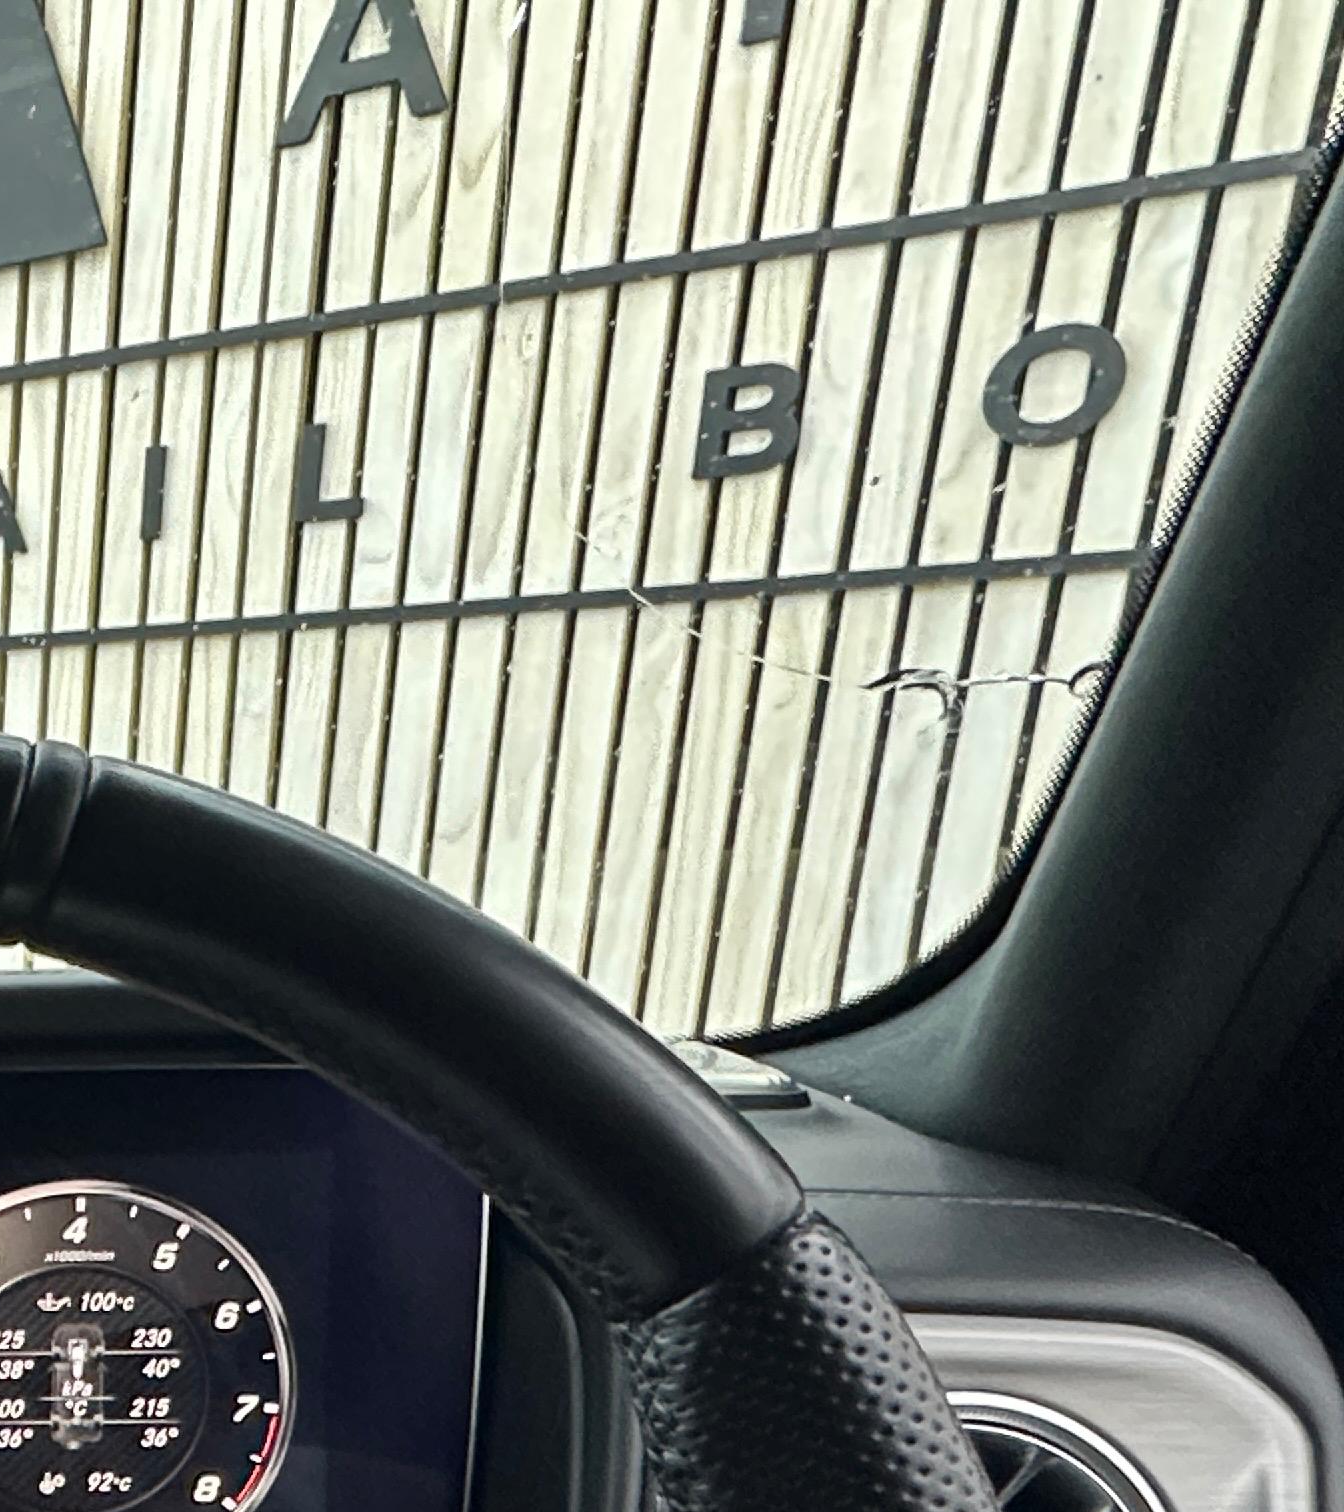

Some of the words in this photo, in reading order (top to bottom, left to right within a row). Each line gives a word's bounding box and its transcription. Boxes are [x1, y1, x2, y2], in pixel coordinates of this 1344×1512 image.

[63, 1217, 88, 1243] 4
[153, 1242, 179, 1270] 5
[214, 1300, 241, 1330] 6
[130, 1328, 173, 1348] 230
[129, 1397, 171, 1417] 215
[232, 1394, 260, 1423] 7
[193, 1474, 222, 1503] 8
